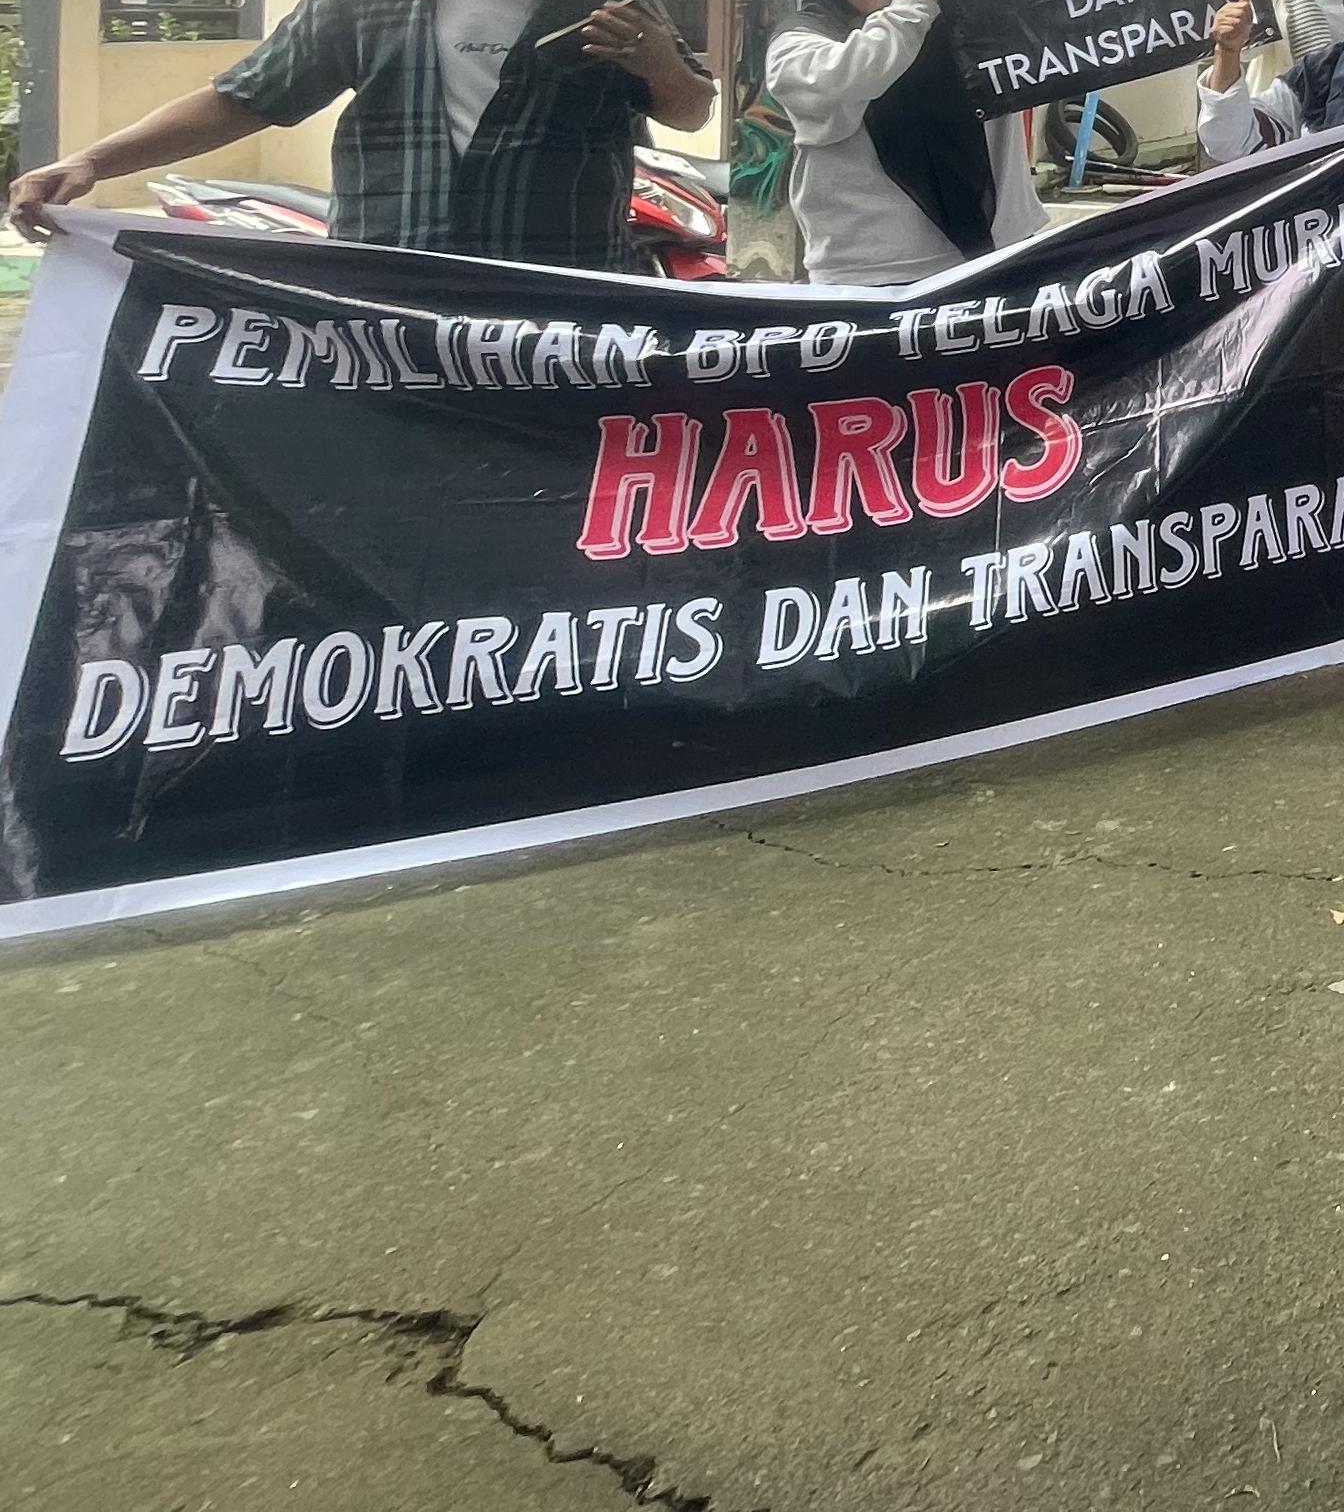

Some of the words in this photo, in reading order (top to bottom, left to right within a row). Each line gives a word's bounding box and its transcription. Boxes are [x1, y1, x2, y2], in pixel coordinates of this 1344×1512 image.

[137, 303, 662, 391] PEMILIHAN
[685, 319, 856, 382] BPD
[889, 252, 1174, 360] TELAGA
[577, 364, 1083, 560] HARUS
[59, 598, 724, 762] DEMOKRATIS
[757, 566, 934, 670] DAN
